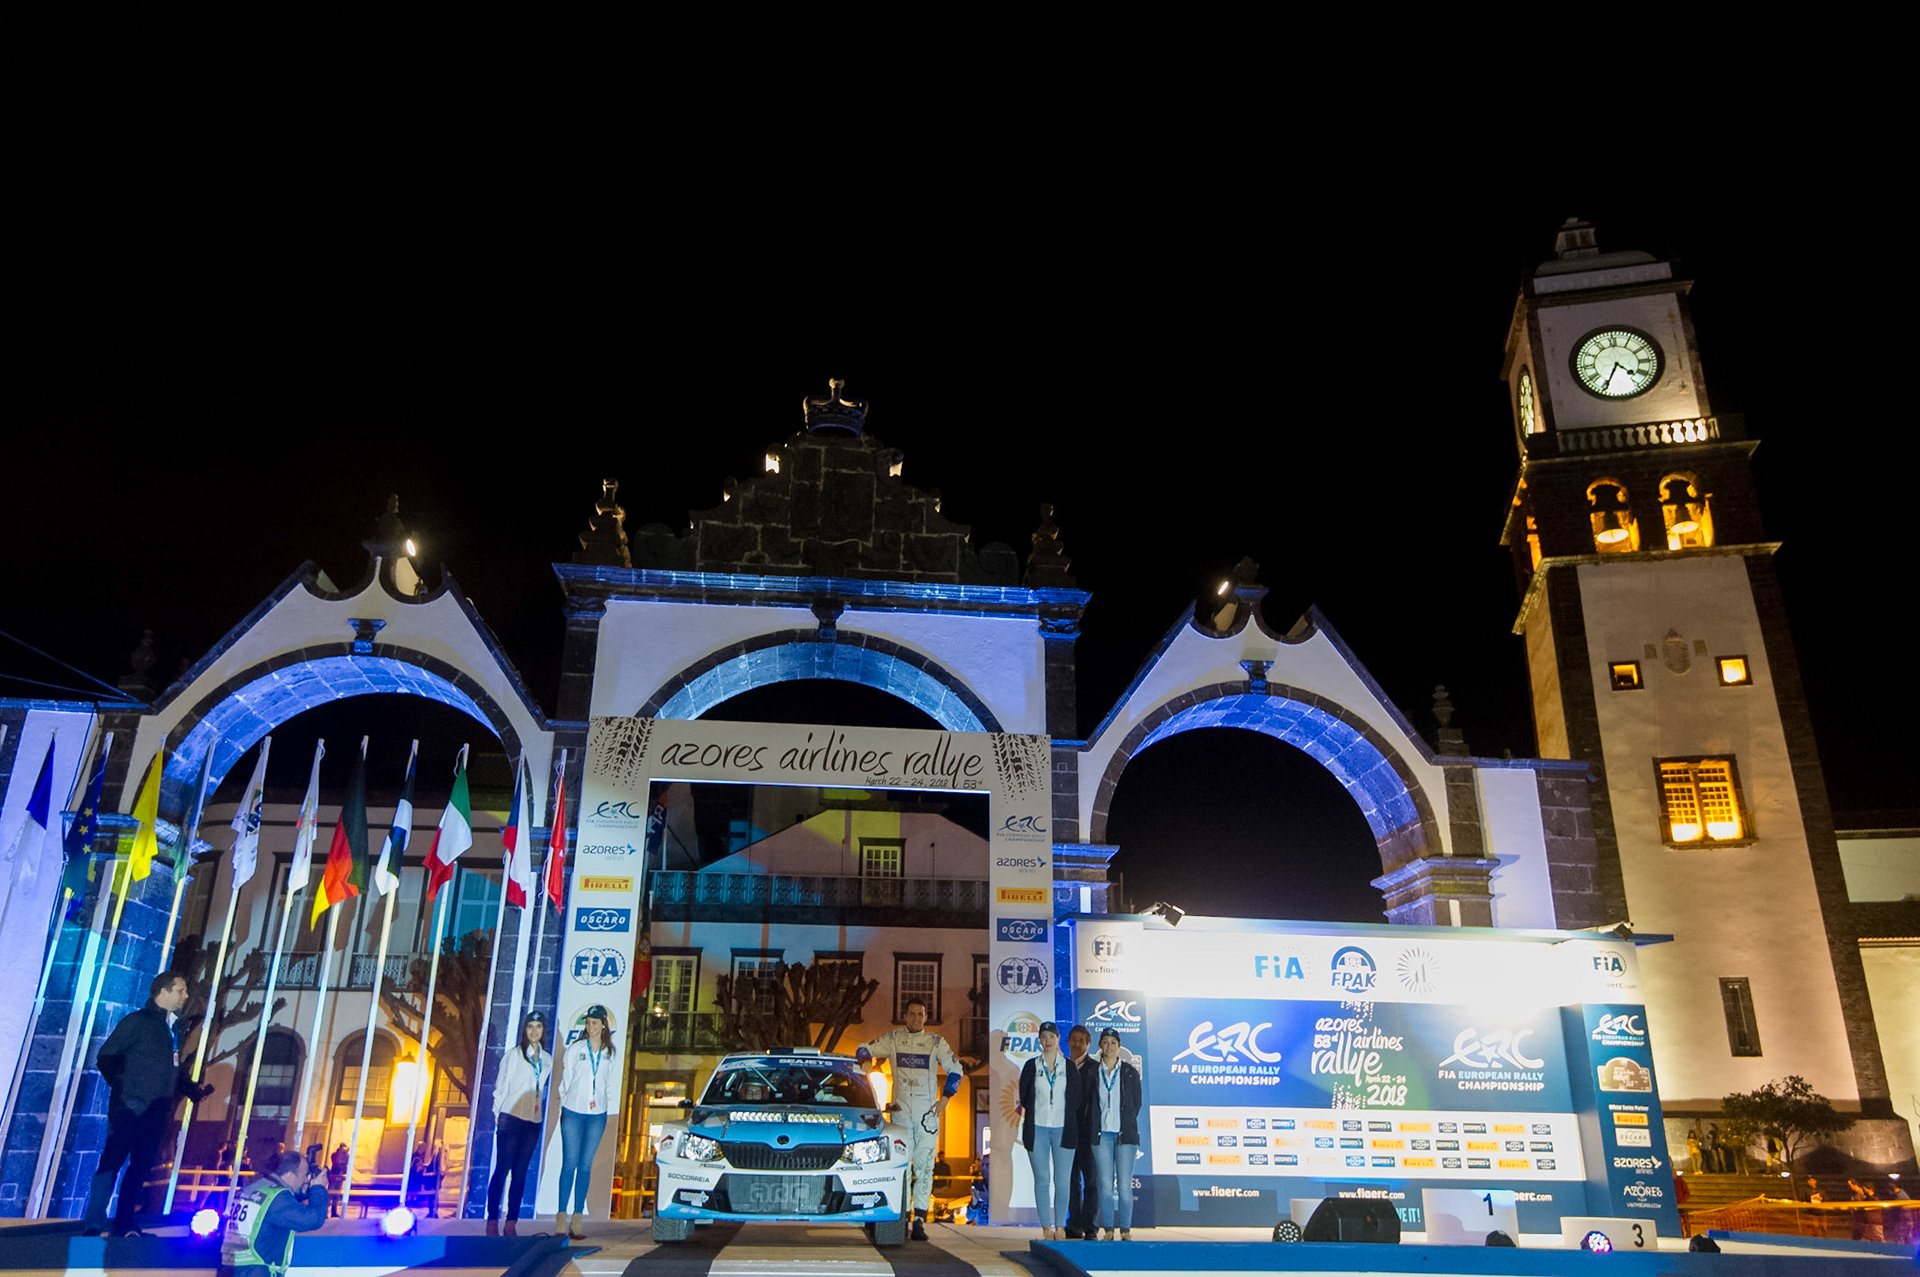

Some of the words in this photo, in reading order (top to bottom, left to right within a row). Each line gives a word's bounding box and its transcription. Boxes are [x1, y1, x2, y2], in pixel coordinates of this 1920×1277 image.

[660, 743, 768, 771] azores
[779, 729, 894, 776] airlines
[903, 732, 984, 789] rallye
[889, 777, 900, 786] 22
[930, 779, 948, 788] 2018
[588, 801, 640, 819] ERC
[998, 815, 1047, 832] ERC
[583, 878, 629, 889] PIRELLI
[1001, 889, 1042, 901] PIRELLI
[580, 915, 626, 925] OSCARO
[1001, 927, 1044, 935] OSCARO
[1331, 971, 1377, 989] FPAK
[1086, 1000, 1141, 1022] ERC
[1315, 1018, 1364, 1033] azores
[1592, 1014, 1644, 1035] ERC
[1172, 1020, 1282, 1064] ERC
[1352, 1026, 1403, 1051] airlines
[1439, 1027, 1544, 1070] ERC
[1310, 1031, 1383, 1087] rallye
[1171, 1063, 1189, 1074] FIA
[1191, 1064, 1246, 1074] EUROPEAN
[1248, 1065, 1281, 1075] RALLY
[1438, 1070, 1456, 1079] FIA
[1458, 1070, 1512, 1080] EUROPEAN
[1514, 1071, 1544, 1081] RALLY
[1190, 1075, 1280, 1086] CHAMPIONSHIP
[1457, 1081, 1545, 1091] CHAMPIONSHIP
[1366, 1084, 1408, 1106] 2018
[667, 1172, 710, 1183] SOCICORREIA
[852, 1176, 896, 1185] SOCICORREIA
[1192, 1186, 1260, 1198] www.fiaerc.com
[1339, 1187, 1405, 1200] www.fiaerc.com
[1623, 1185, 1663, 1198] AZORES
[1482, 1192, 1494, 1216] 1
[1632, 1223, 1644, 1248] 3
